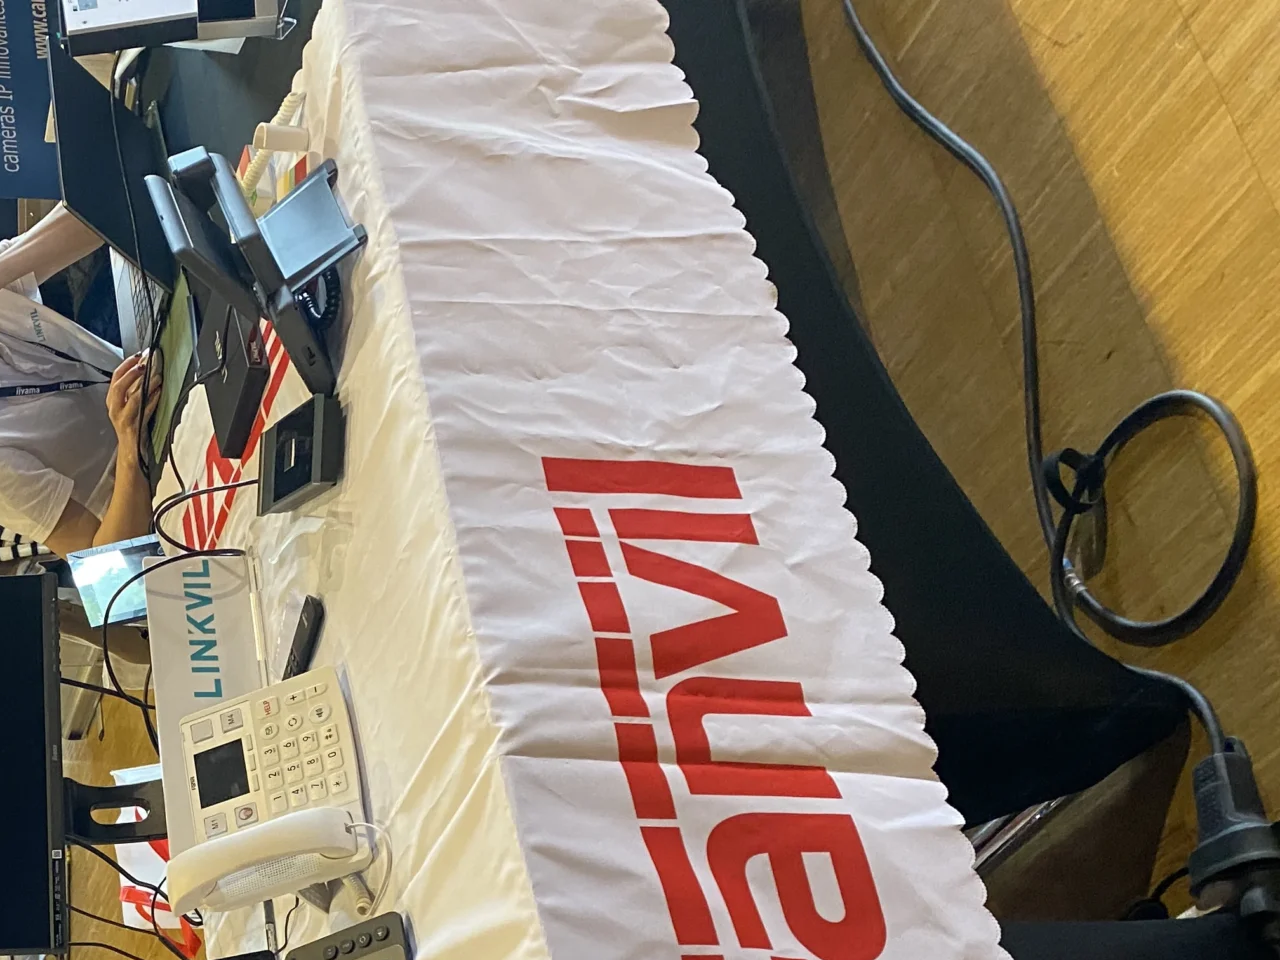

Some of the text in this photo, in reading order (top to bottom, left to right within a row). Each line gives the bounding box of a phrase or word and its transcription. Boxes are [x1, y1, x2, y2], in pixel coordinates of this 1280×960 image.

[29, 307, 46, 342] LINKVIL
[182, 559, 223, 698] LINKVIL
[262, 700, 272, 716] HELP
[227, 713, 237, 725] M4
[210, 819, 219, 830] M1
